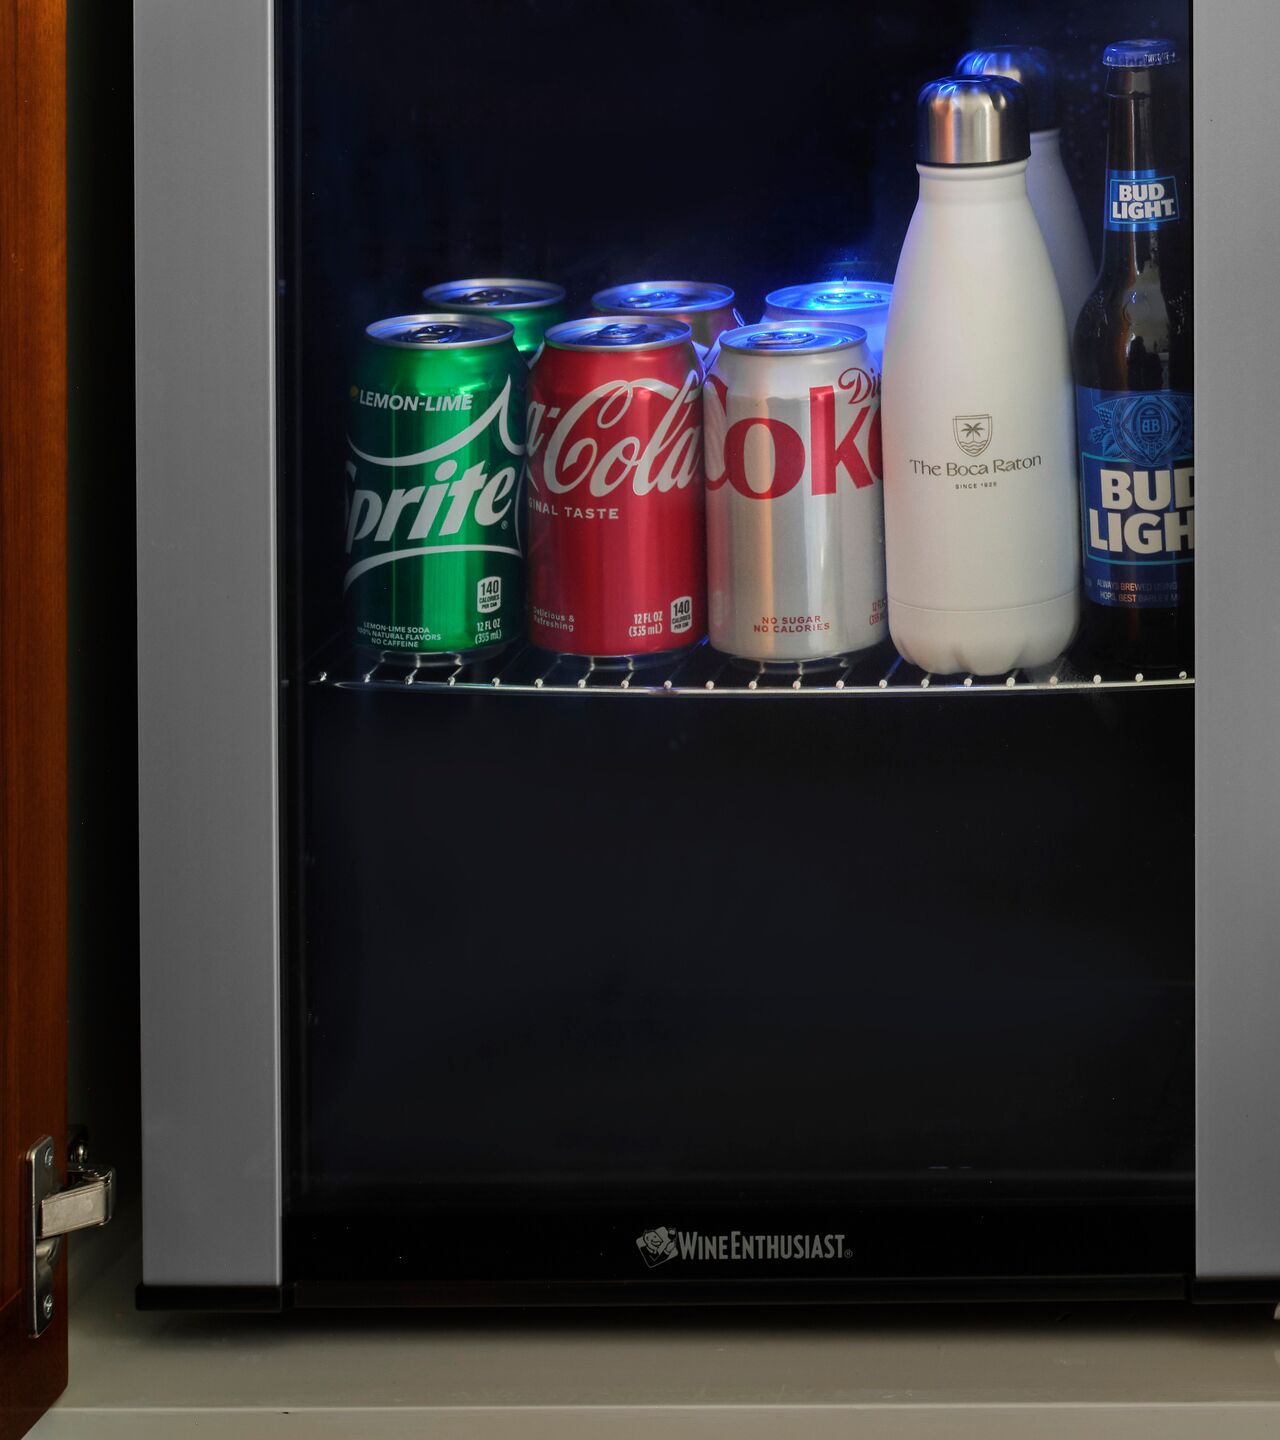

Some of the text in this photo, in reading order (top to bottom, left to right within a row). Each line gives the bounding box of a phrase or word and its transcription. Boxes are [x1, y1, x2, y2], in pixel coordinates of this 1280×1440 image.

[1119, 183, 1165, 202] BUD
[1112, 198, 1174, 220] LIGHT
[359, 389, 474, 411] LEMON-LIME
[909, 455, 1042, 477] The Boca Raton
[564, 506, 619, 520] TASTE
[1089, 508, 1194, 554] LIGH
[481, 579, 500, 596] 140
[1119, 593, 1137, 603] BEST
[673, 599, 690, 616] 140
[476, 618, 501, 632] 12 FL OZ
[568, 614, 575, 623] &
[633, 611, 663, 625] 12 FL OZ
[762, 615, 822, 625] NO SUGAR
[363, 621, 430, 634] LEMON-LIME SODA
[753, 622, 830, 633] NO CALORIES
[372, 631, 404, 641] NATURAL
[405, 633, 442, 641] FLAVORS
[474, 632, 490, 645] (355
[383, 639, 419, 648] CAFFEINE
